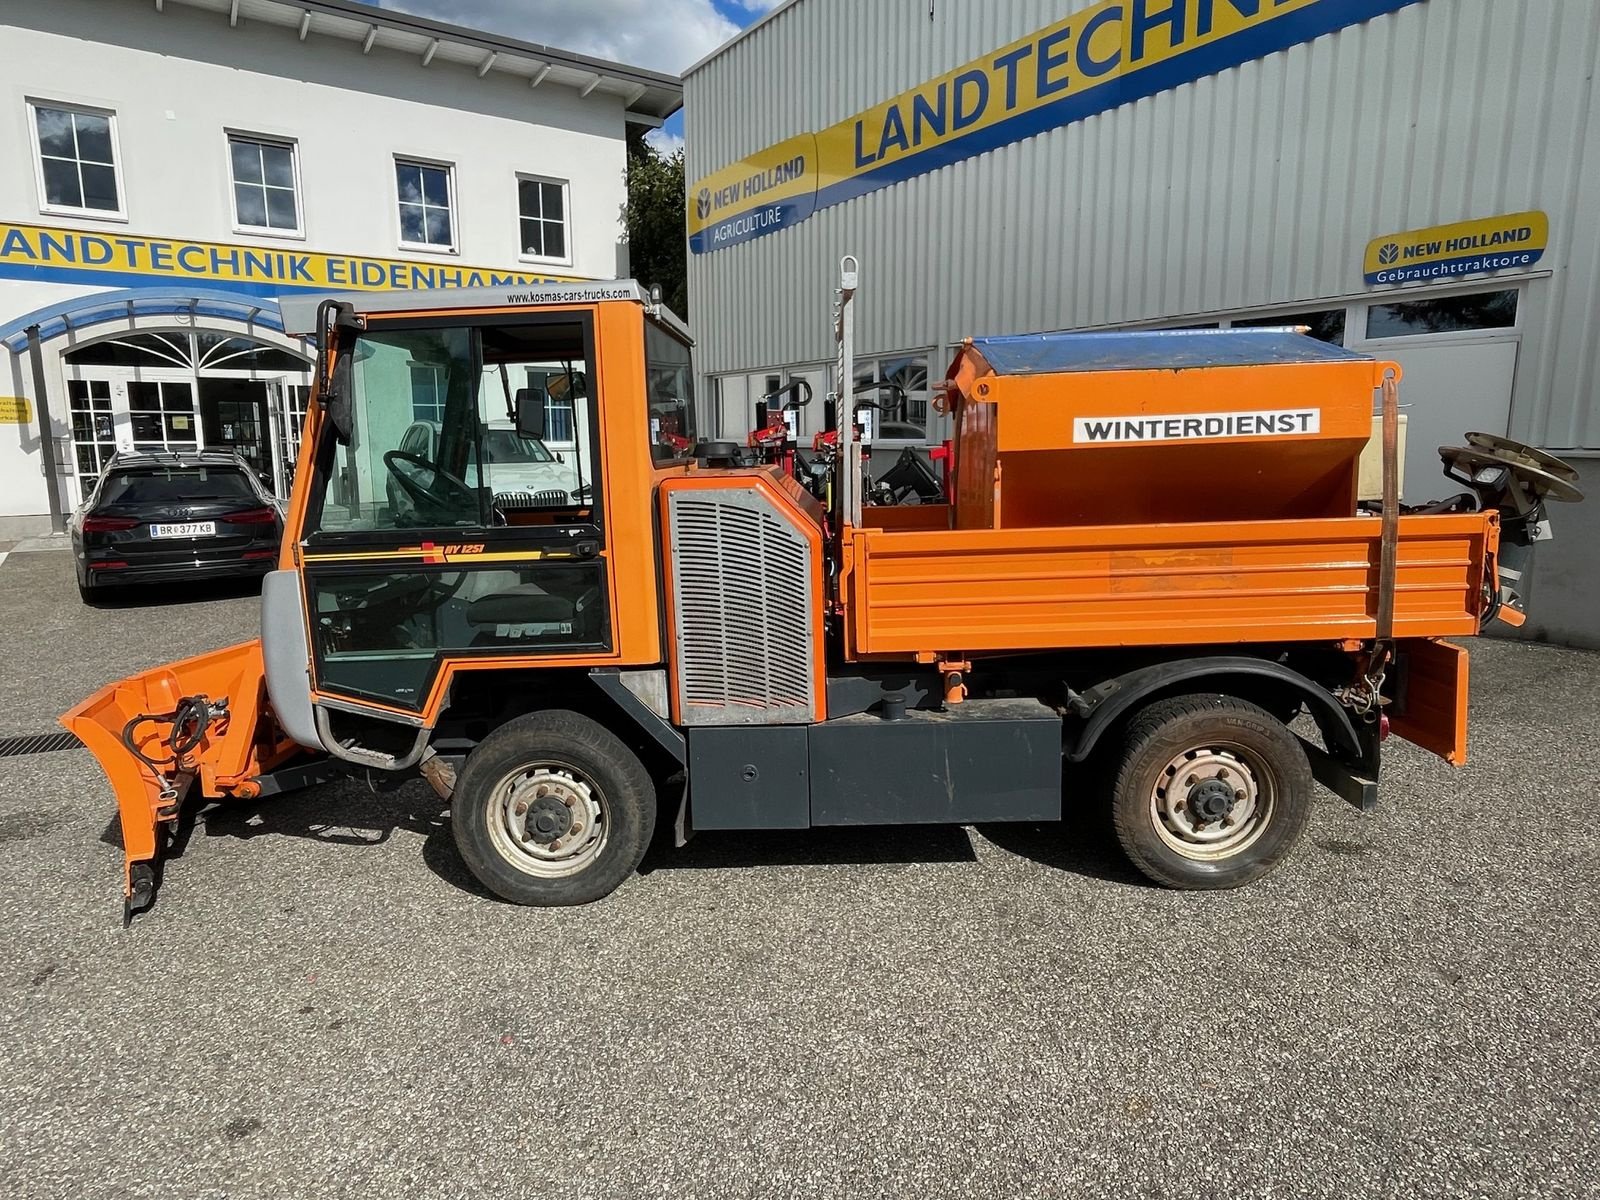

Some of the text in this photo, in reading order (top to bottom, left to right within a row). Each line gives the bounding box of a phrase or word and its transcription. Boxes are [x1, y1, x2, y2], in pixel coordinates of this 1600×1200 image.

[855, 0, 1289, 169] LANDTECH
[714, 155, 805, 210] NEW HOLLAND
[713, 206, 781, 243] AGRICULTURE
[1403, 226, 1532, 259] NEW HOLLAND
[1376, 254, 1530, 283] Gebrauchttraktore
[507, 288, 631, 304] www.kosmas-cars-trucks.com
[1083, 413, 1314, 441] WINTERDIENST
[160, 524, 212, 535] BR 377 KB
